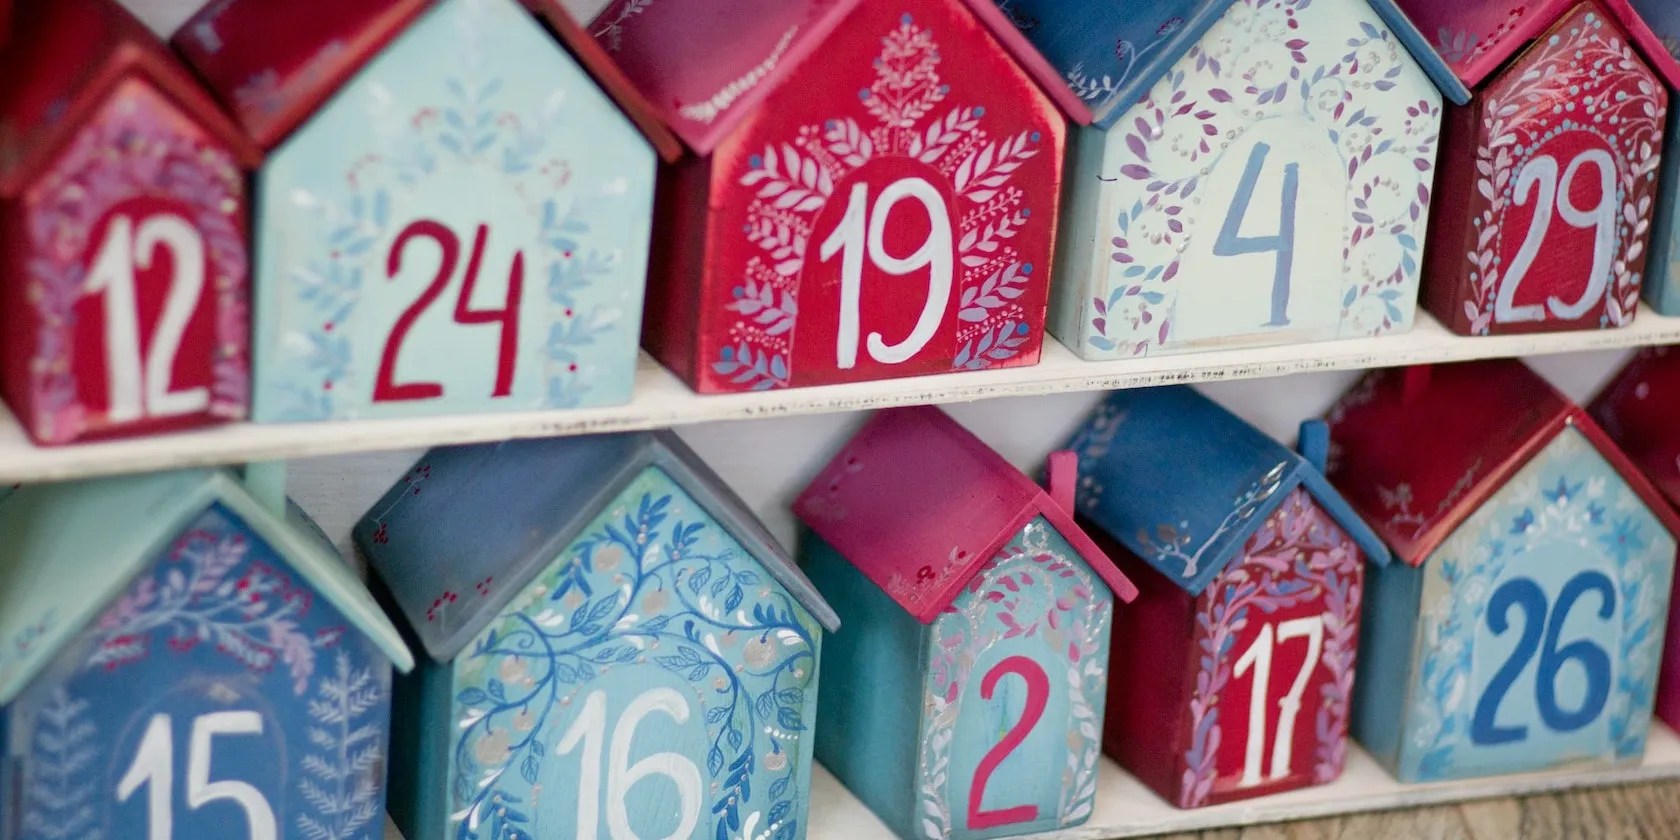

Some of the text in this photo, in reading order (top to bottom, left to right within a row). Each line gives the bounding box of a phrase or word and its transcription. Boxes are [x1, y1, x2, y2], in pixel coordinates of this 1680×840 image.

[83, 213, 210, 422] 12
[372, 219, 524, 403] 24
[819, 181, 953, 370] 19
[1212, 142, 1299, 328] 4
[1494, 148, 1618, 323] 29
[966, 655, 1050, 830] 2
[1233, 615, 1324, 787] 17
[1470, 570, 1616, 748] 26
[116, 711, 278, 840] 15
[556, 687, 703, 840] 16
